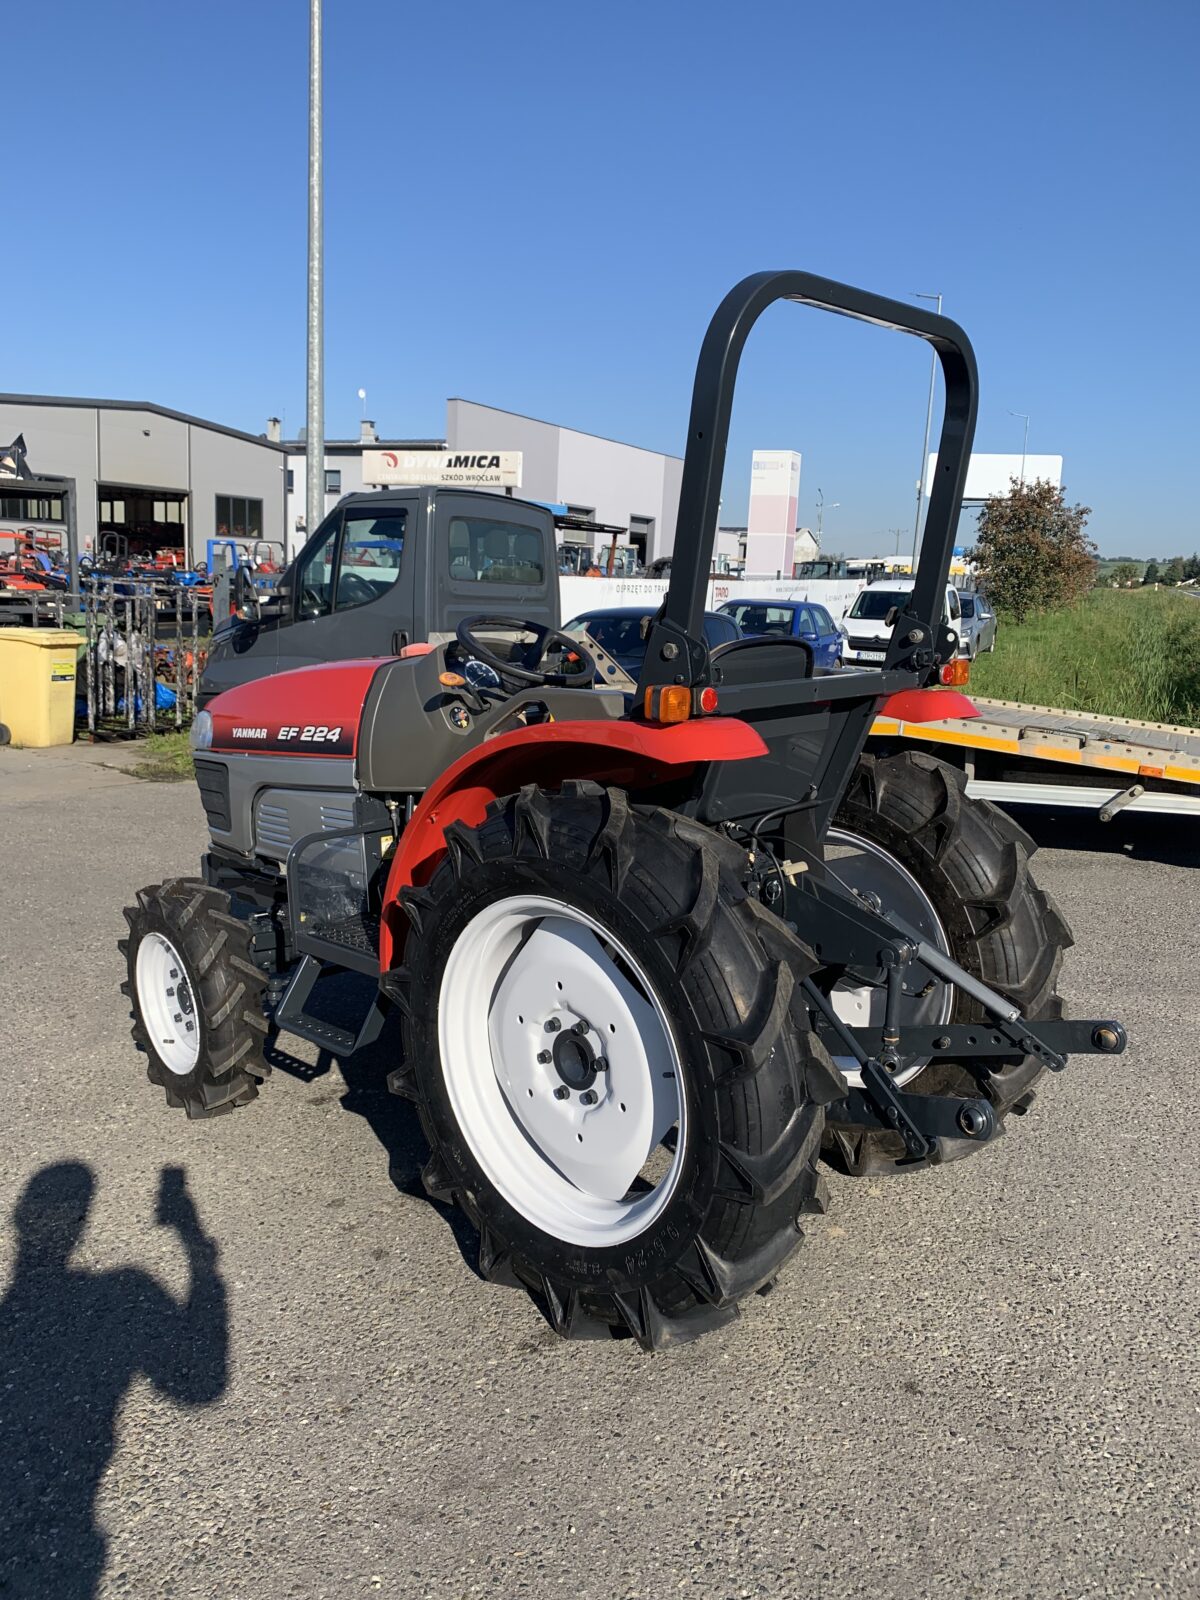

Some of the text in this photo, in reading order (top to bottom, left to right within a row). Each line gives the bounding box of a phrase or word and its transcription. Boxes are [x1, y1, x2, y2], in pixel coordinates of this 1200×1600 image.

[403, 455, 501, 469] DYNAMICA
[465, 474, 501, 482] WROCŁAW
[616, 585, 643, 594] OSPRZĘT
[644, 585, 652, 593] DO
[232, 726, 342, 743] YANMAR EF 224
